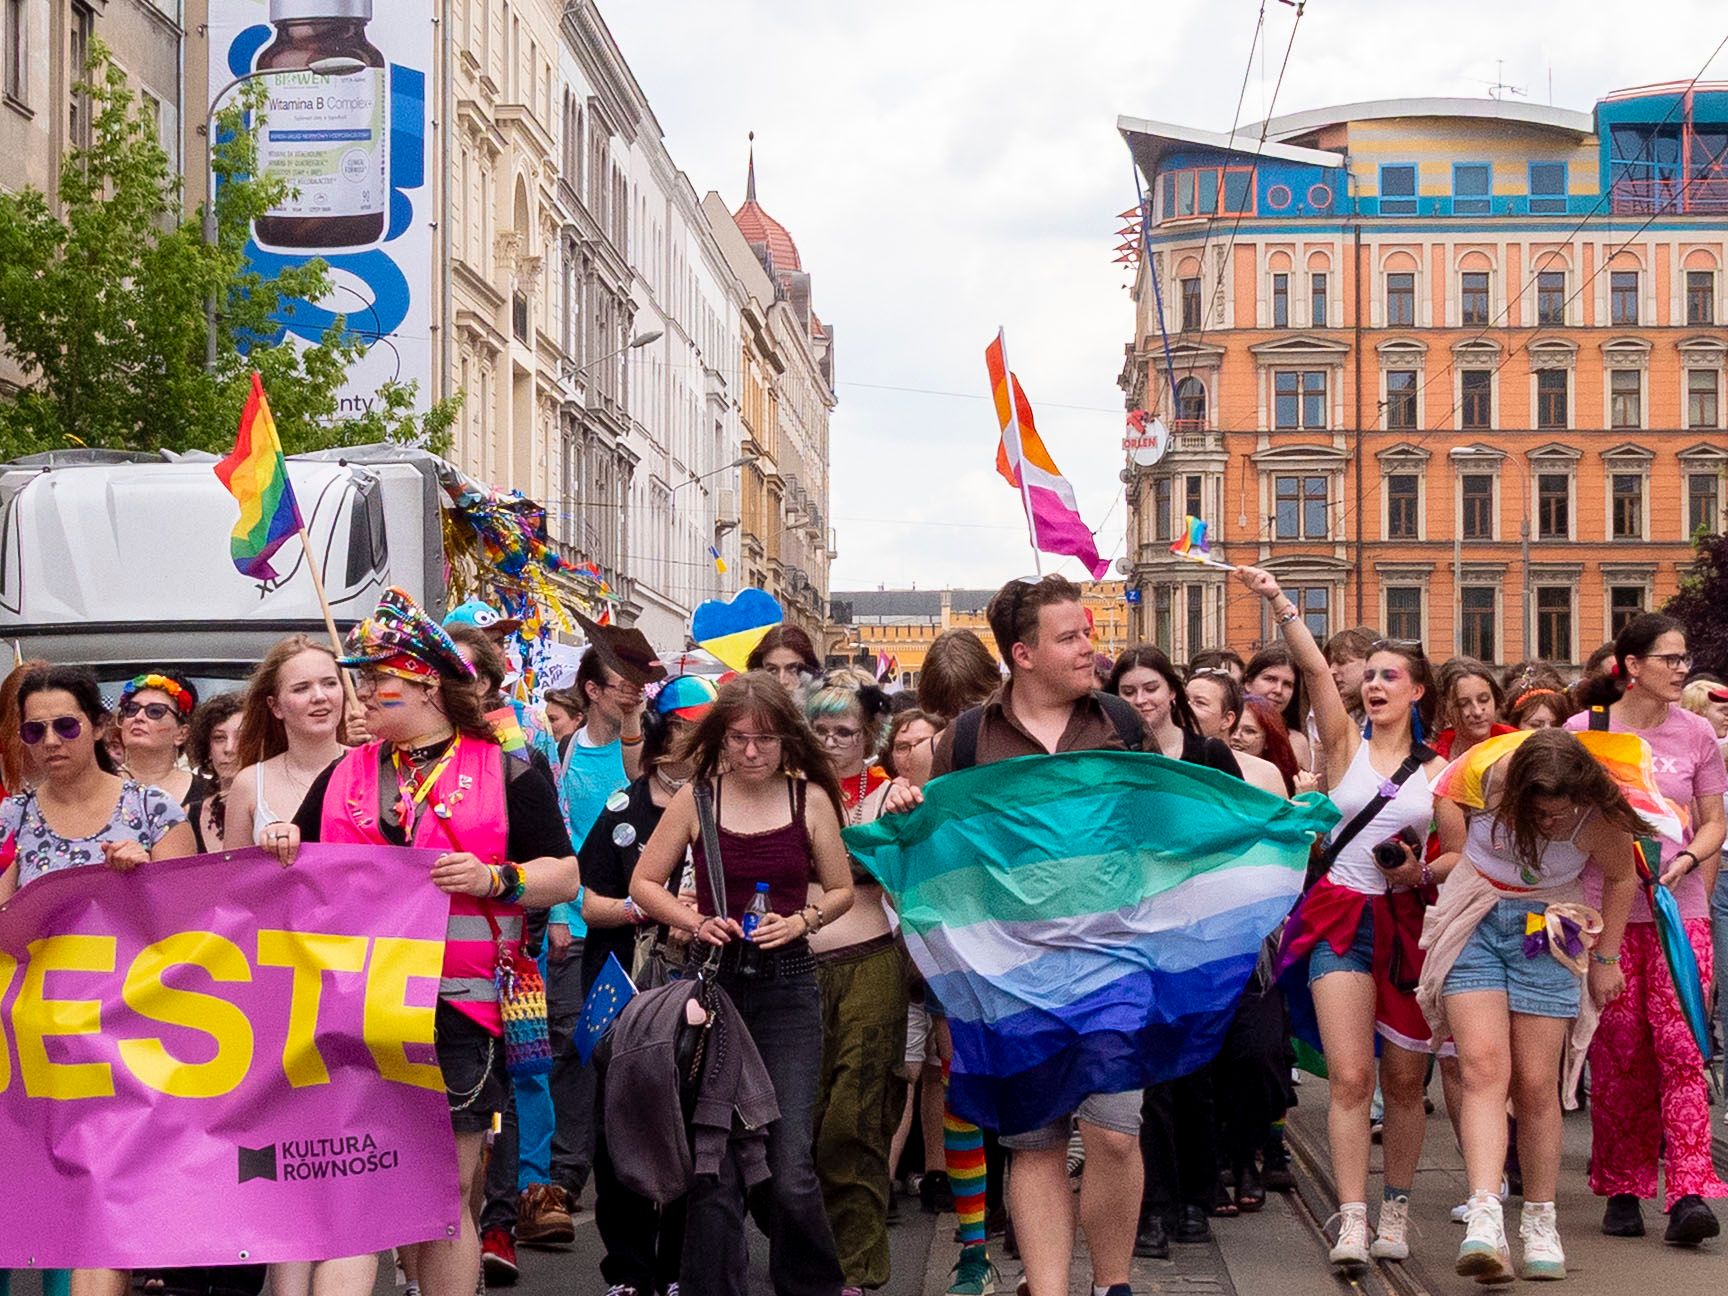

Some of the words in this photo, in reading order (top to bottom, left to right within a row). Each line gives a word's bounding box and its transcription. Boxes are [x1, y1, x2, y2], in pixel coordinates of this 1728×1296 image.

[317, 97, 325, 109] B
[1123, 438, 1157, 448] ORLEN
[282, 1133, 377, 1159] KULTURA
[284, 1150, 399, 1181] RÓWNOŚCI
